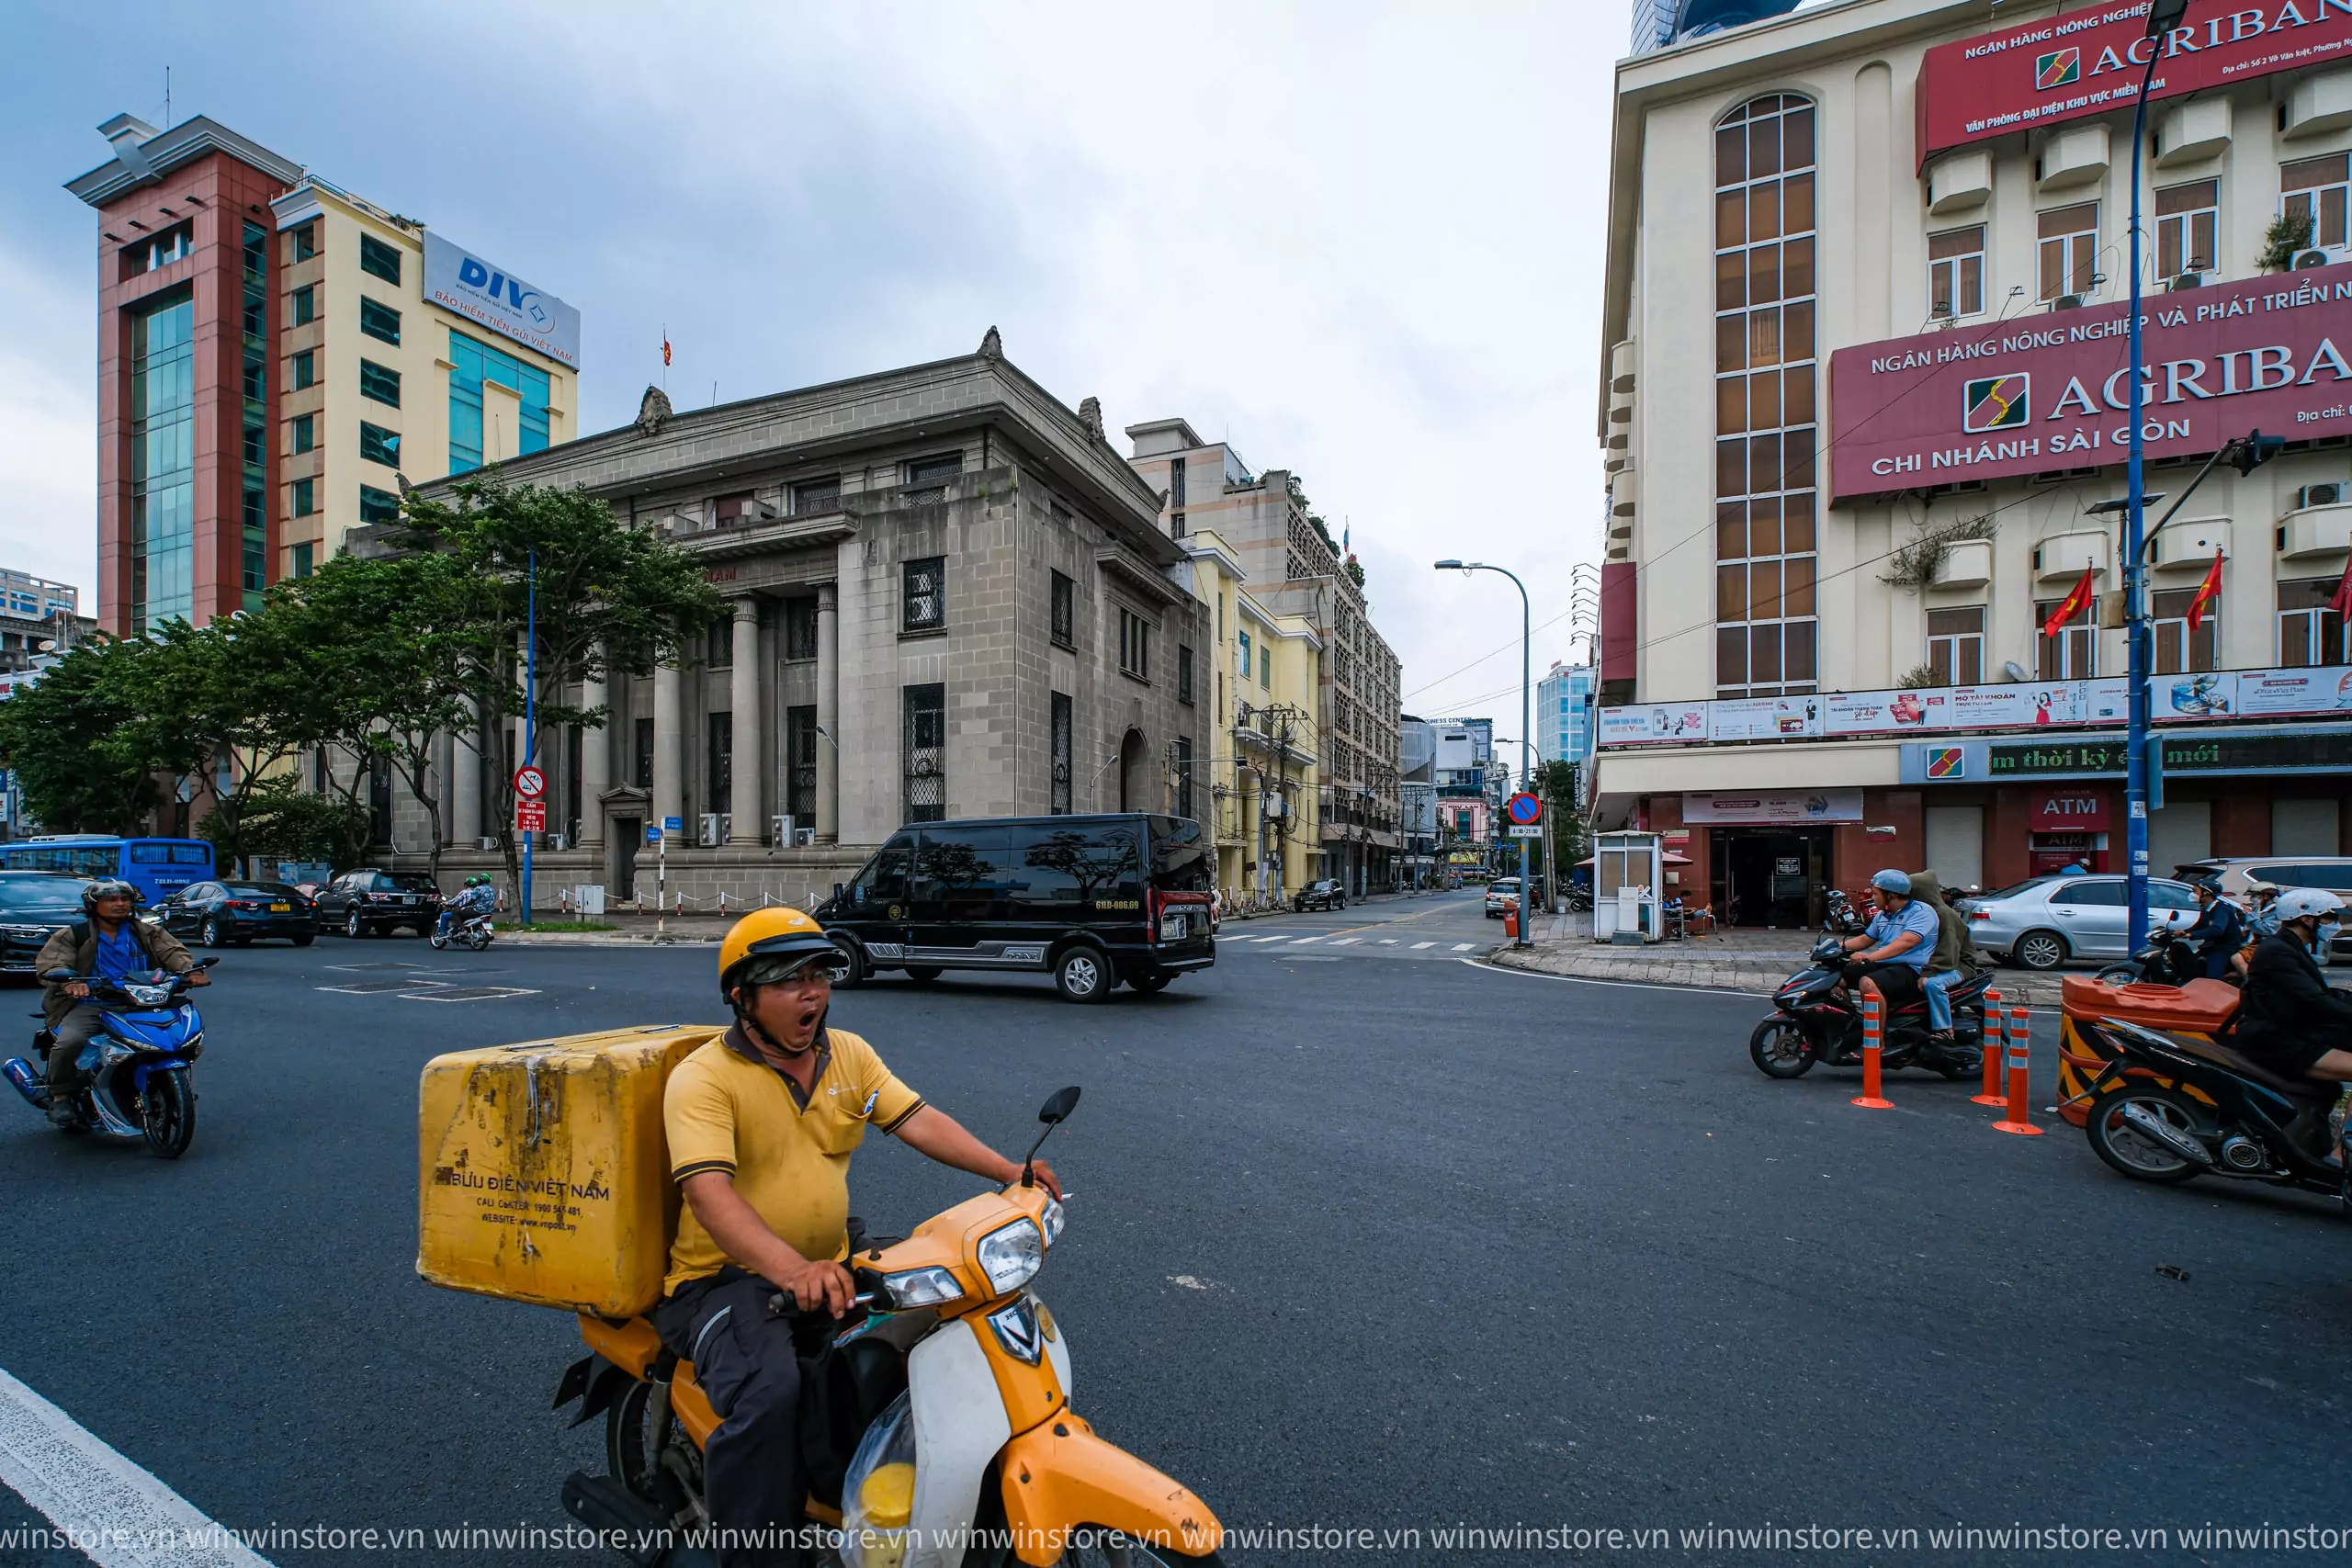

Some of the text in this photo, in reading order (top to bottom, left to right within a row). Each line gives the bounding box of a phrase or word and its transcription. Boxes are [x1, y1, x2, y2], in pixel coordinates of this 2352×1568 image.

[1964, 39, 2007, 60] NGÂN
[2009, 28, 2052, 50] HÀNG
[2055, 17, 2098, 39] NÔNG
[1965, 118, 1985, 133] VĂN
[1986, 110, 2021, 129] PHÒNG
[2022, 106, 2040, 120] ĐẠI
[2065, 96, 2088, 110] KHU
[2112, 81, 2138, 99] MIỀN
[1871, 349, 1932, 374] NGÂN
[1936, 340, 1997, 365] HÀNG
[2002, 326, 2065, 354] NÔNG
[2157, 305, 2188, 328] VÀ
[2197, 295, 2256, 322] PHÁT
[2263, 277, 2329, 313] TRIỂN
[552, 347, 573, 362] NAM
[1871, 417, 2190, 476] CHI NHÁNH SÀI GÒN
[2023, 750, 2073, 767] thời
[2167, 744, 2219, 762] mới
[2043, 798, 2097, 815] ATM
[571, 1184, 609, 1201] NAM
